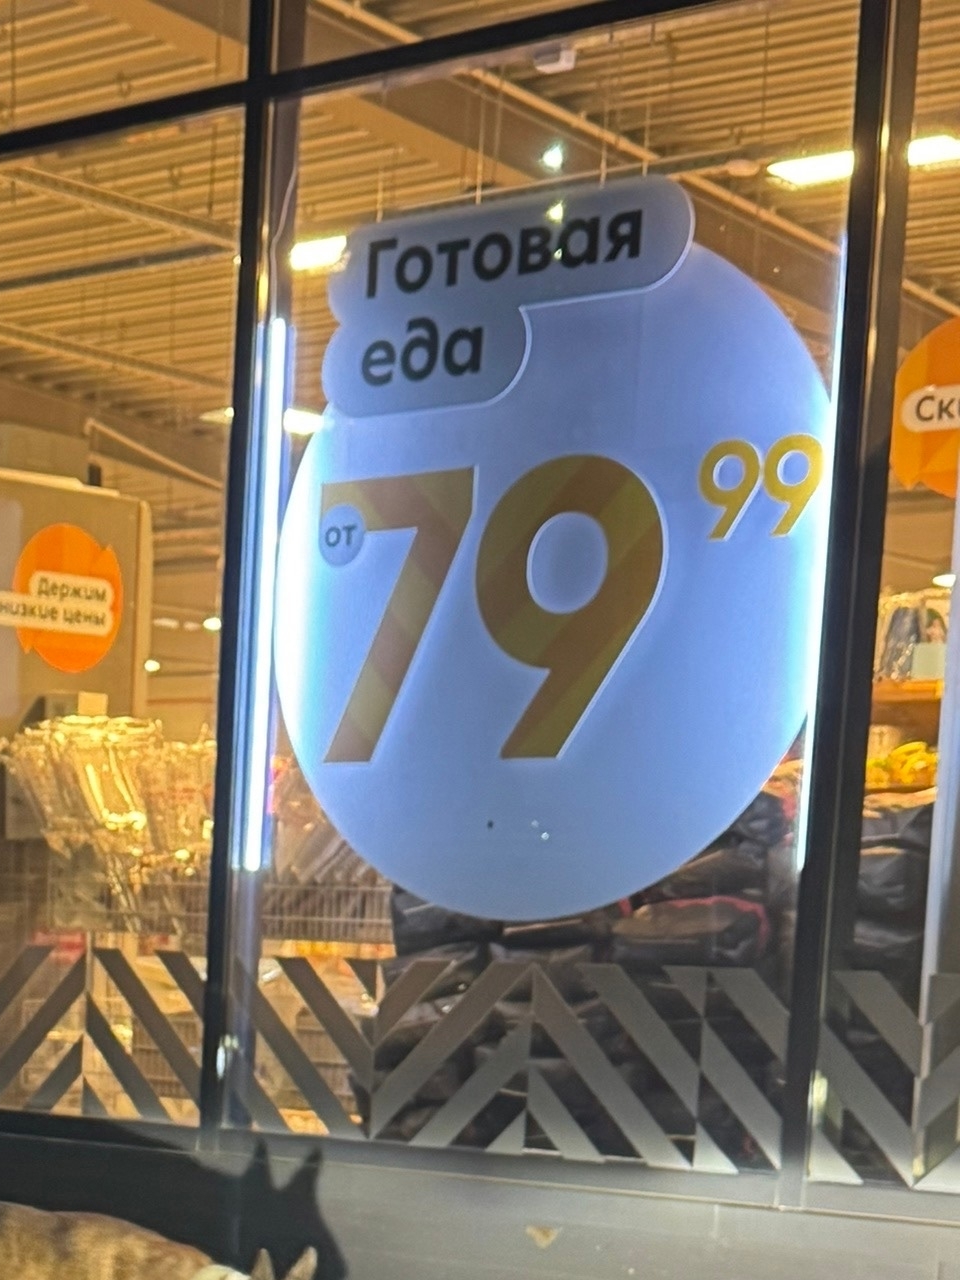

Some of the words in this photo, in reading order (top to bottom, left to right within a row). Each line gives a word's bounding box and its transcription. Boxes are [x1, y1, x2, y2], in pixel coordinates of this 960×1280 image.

[366, 209, 643, 299] Готовая
[361, 317, 484, 387] еда
[915, 394, 960, 421] Ск
[697, 433, 824, 541] 99
[324, 526, 358, 549] от
[36, 576, 107, 602] Держим
[321, 453, 667, 763] 79
[63, 608, 106, 627] цены
